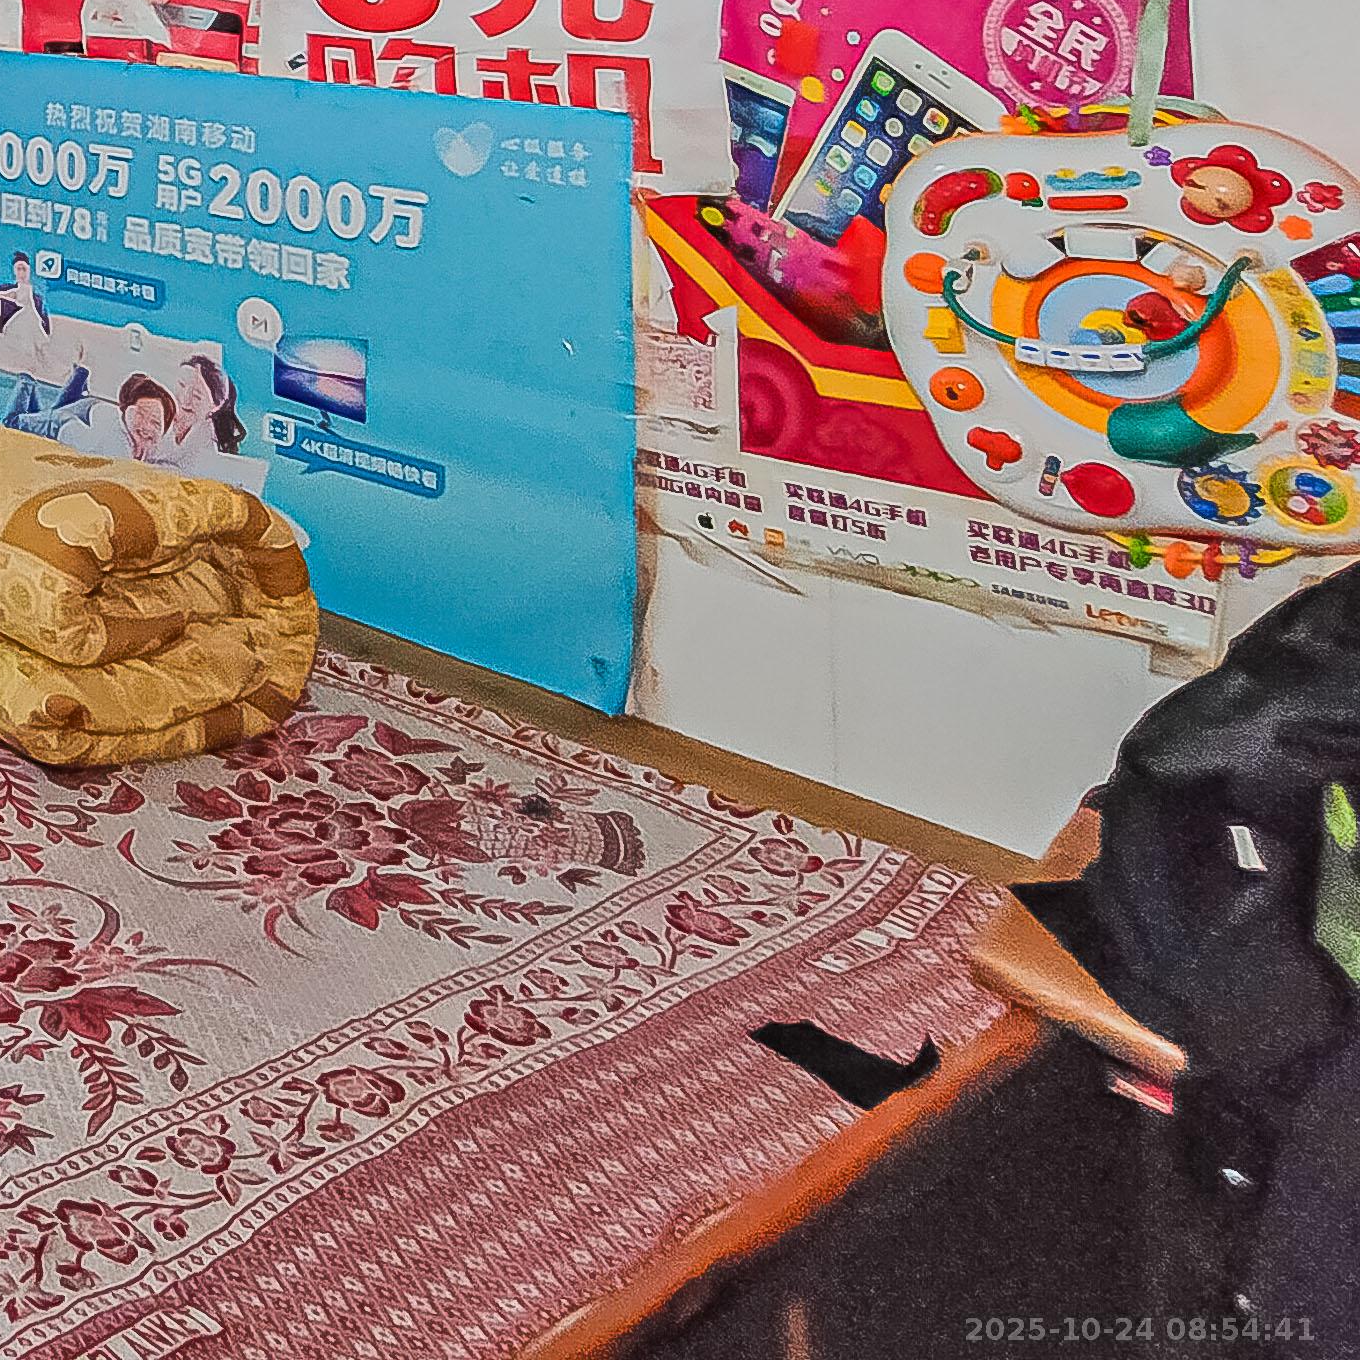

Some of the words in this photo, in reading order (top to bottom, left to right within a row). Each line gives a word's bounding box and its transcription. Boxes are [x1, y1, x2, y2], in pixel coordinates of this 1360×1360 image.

[45, 102, 257, 154] 热烈祝贺湖南移动
[156, 153, 203, 187] 5G
[155, 185, 203, 213] 用户
[207, 162, 429, 250] 2000万
[123, 215, 351, 291] 品质宽带领回家
